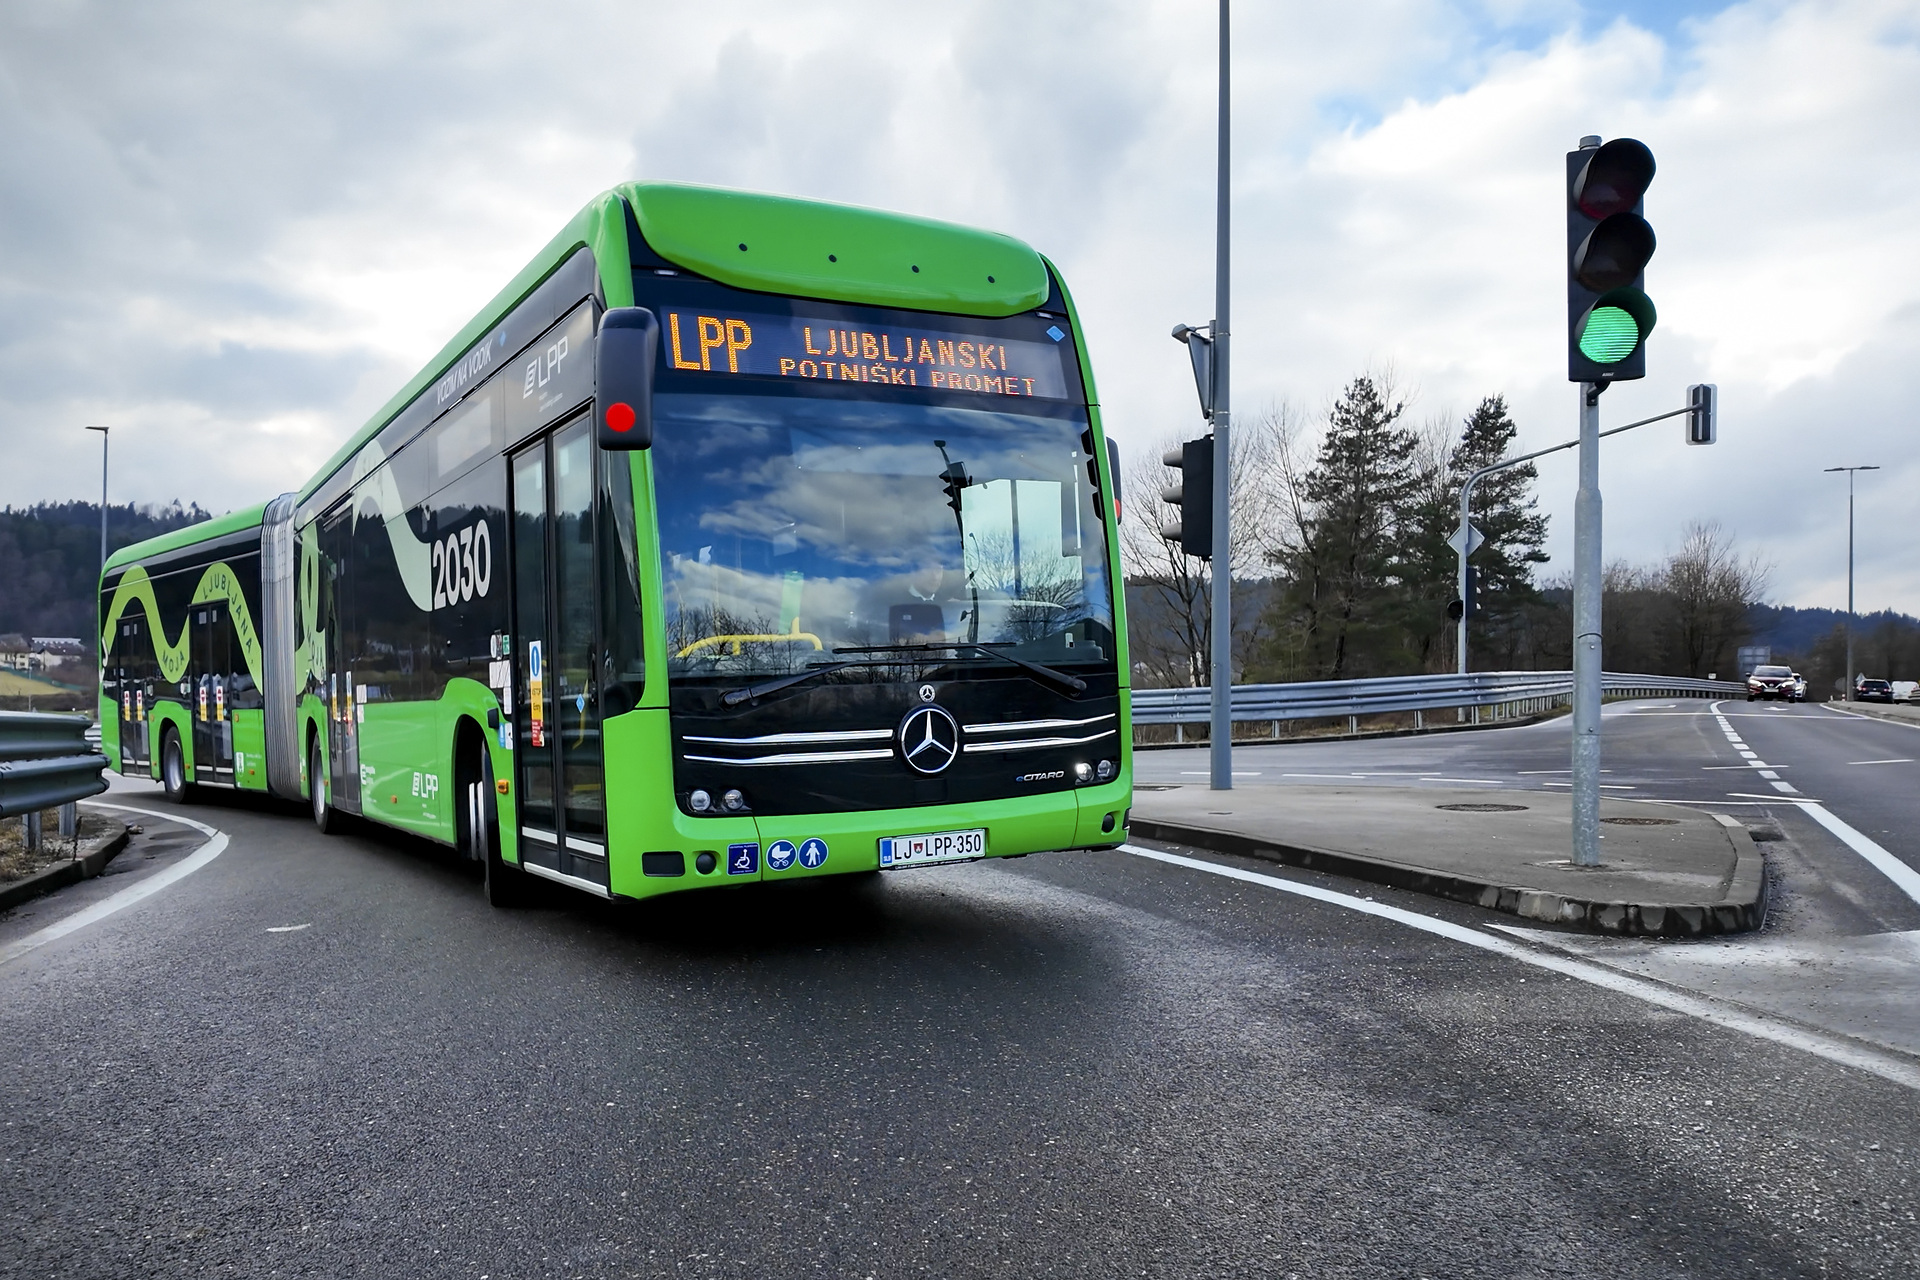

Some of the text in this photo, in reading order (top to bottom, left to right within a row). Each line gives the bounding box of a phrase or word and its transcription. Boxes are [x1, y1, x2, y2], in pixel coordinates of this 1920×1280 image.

[538, 336, 568, 388] LPP
[669, 313, 752, 372] LPP
[803, 327, 1007, 370] LJUBLJANSKI
[780, 357, 1035, 396] POTNIŠKI PROMET
[433, 519, 491, 610] 2030
[163, 650, 185, 673] MOJA
[420, 772, 439, 800] LPP
[1015, 770, 1065, 782] eCITARO
[894, 833, 981, 860] LJ LPP-350
